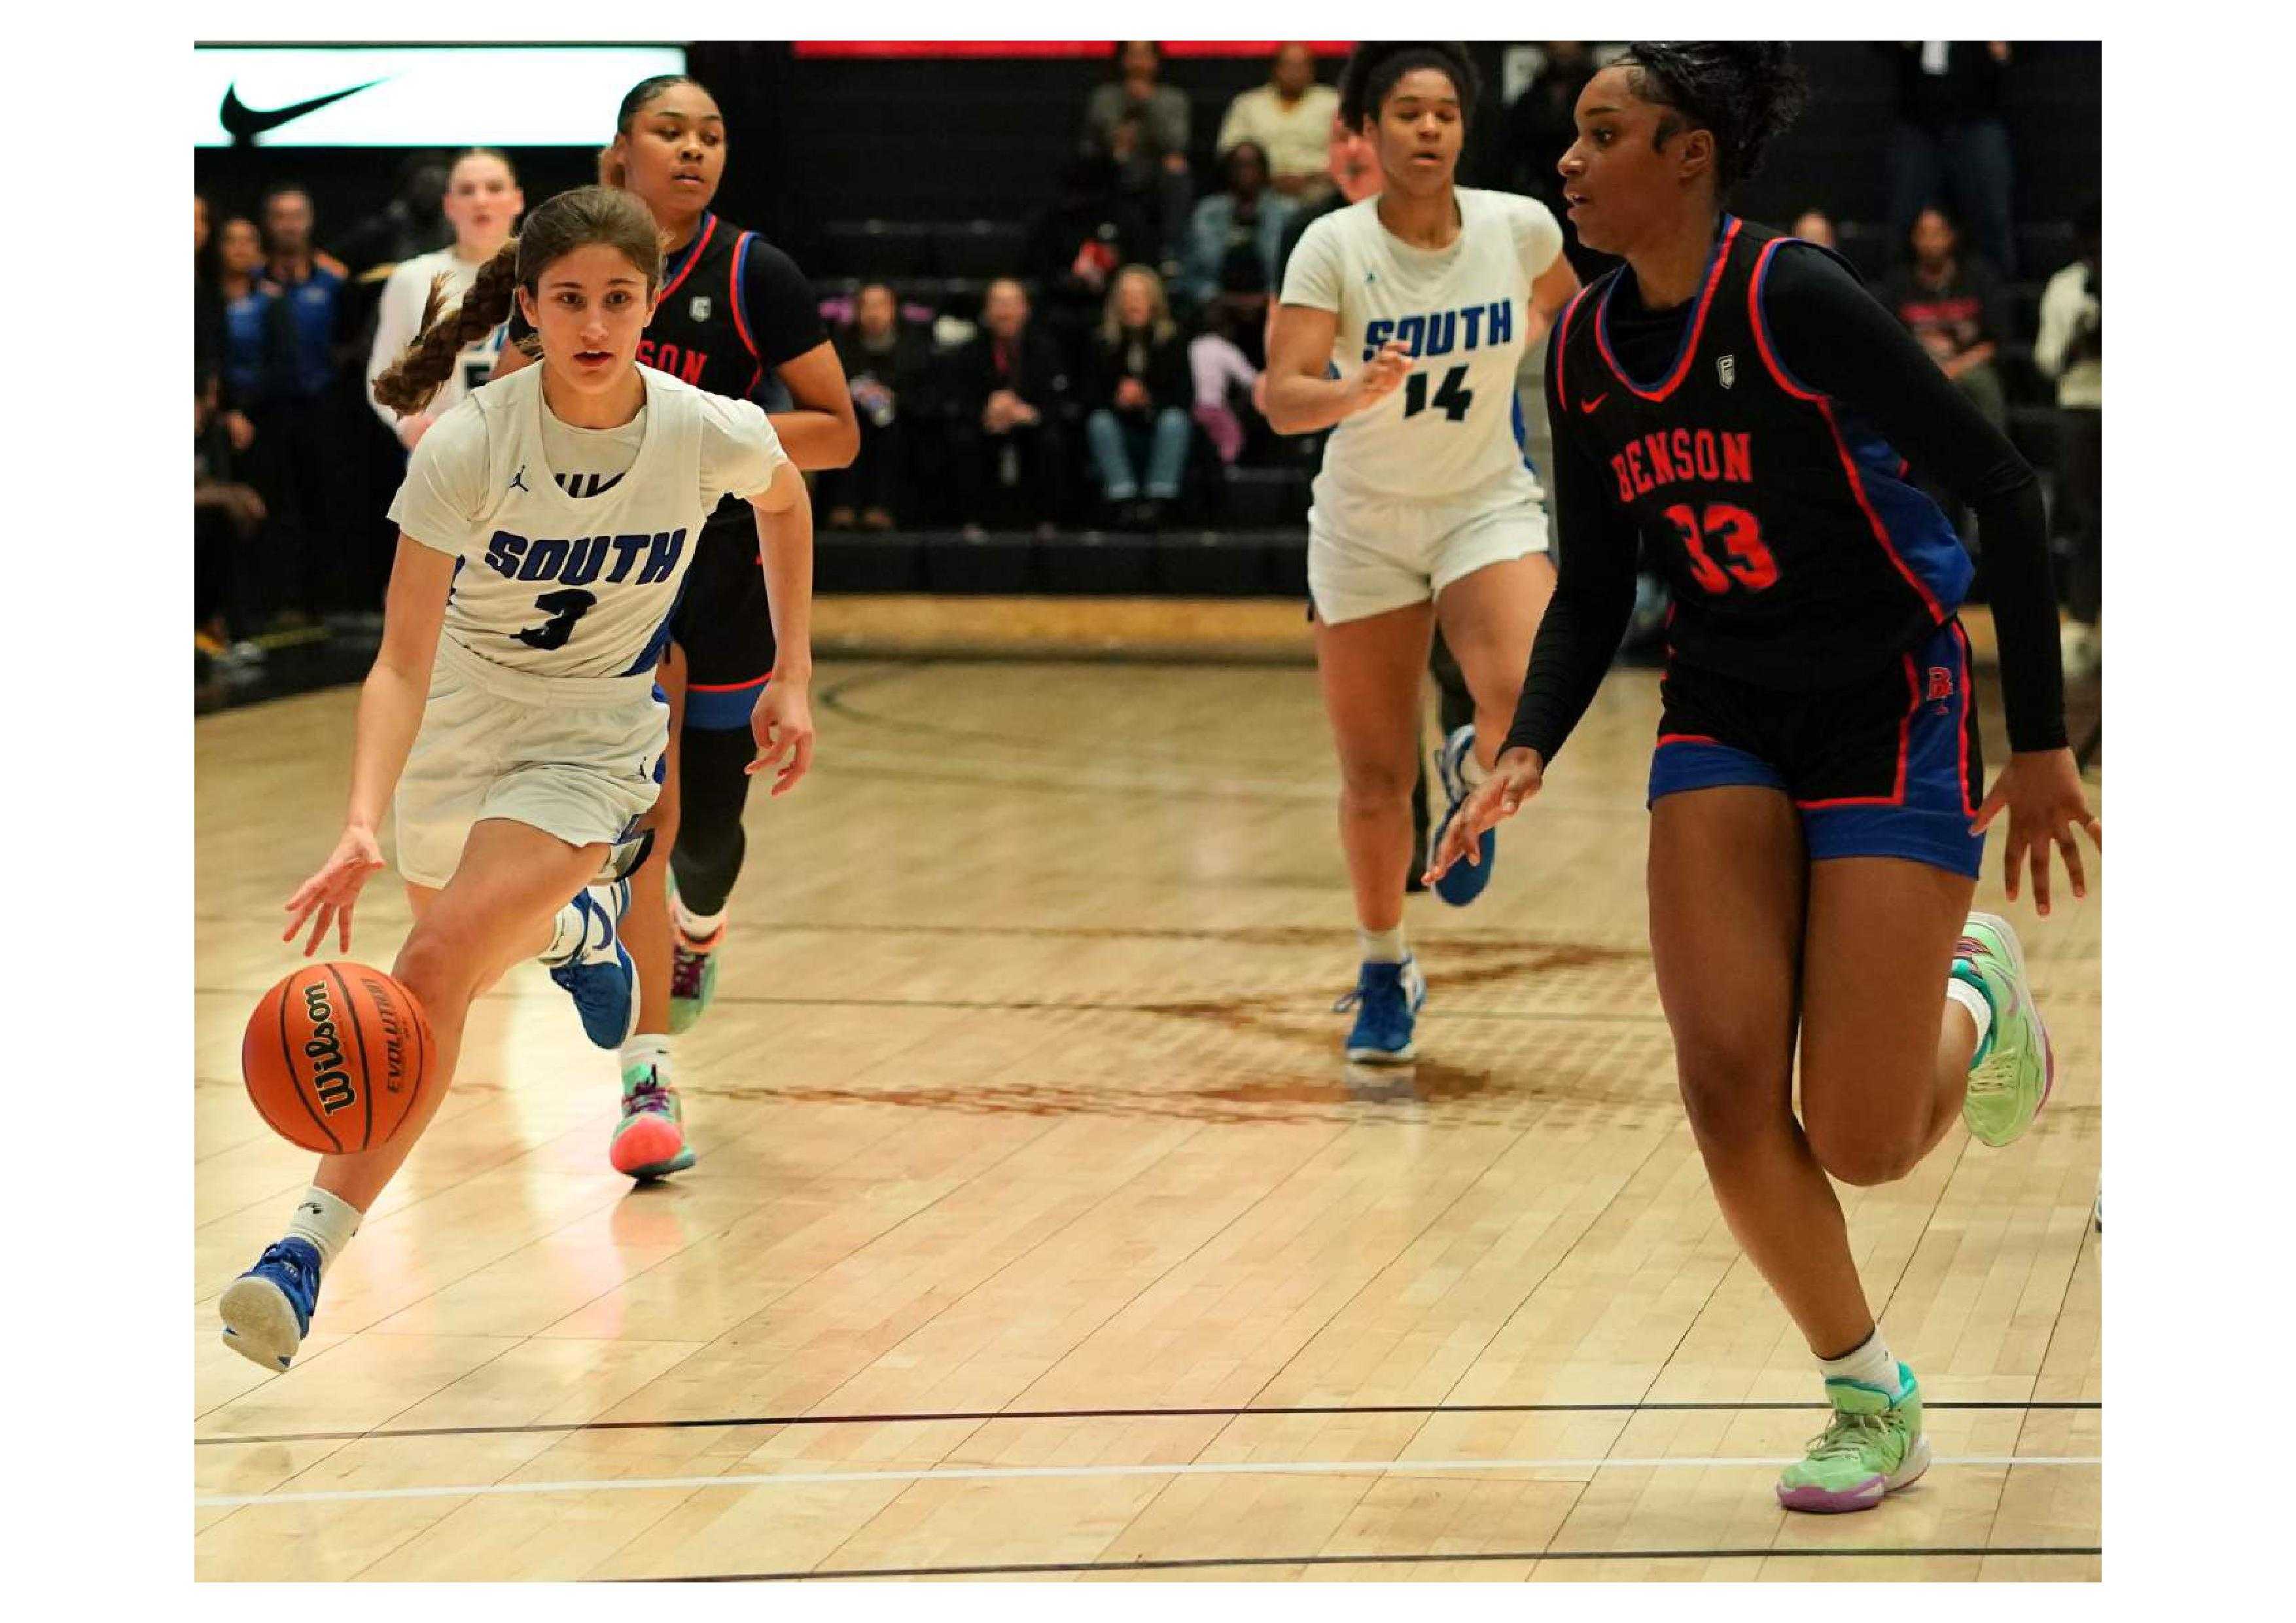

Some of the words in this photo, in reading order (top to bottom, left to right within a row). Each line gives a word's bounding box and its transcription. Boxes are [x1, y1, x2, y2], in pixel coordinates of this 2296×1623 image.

[1362, 297, 1512, 363] SOUTH
[633, 339, 708, 386] SON
[1404, 361, 1474, 421] 14
[1610, 427, 1754, 503] BENSON
[484, 527, 687, 586] SOUTH
[1662, 503, 1782, 594] 33
[520, 588, 597, 651] 3
[303, 980, 357, 1115] Wilson
